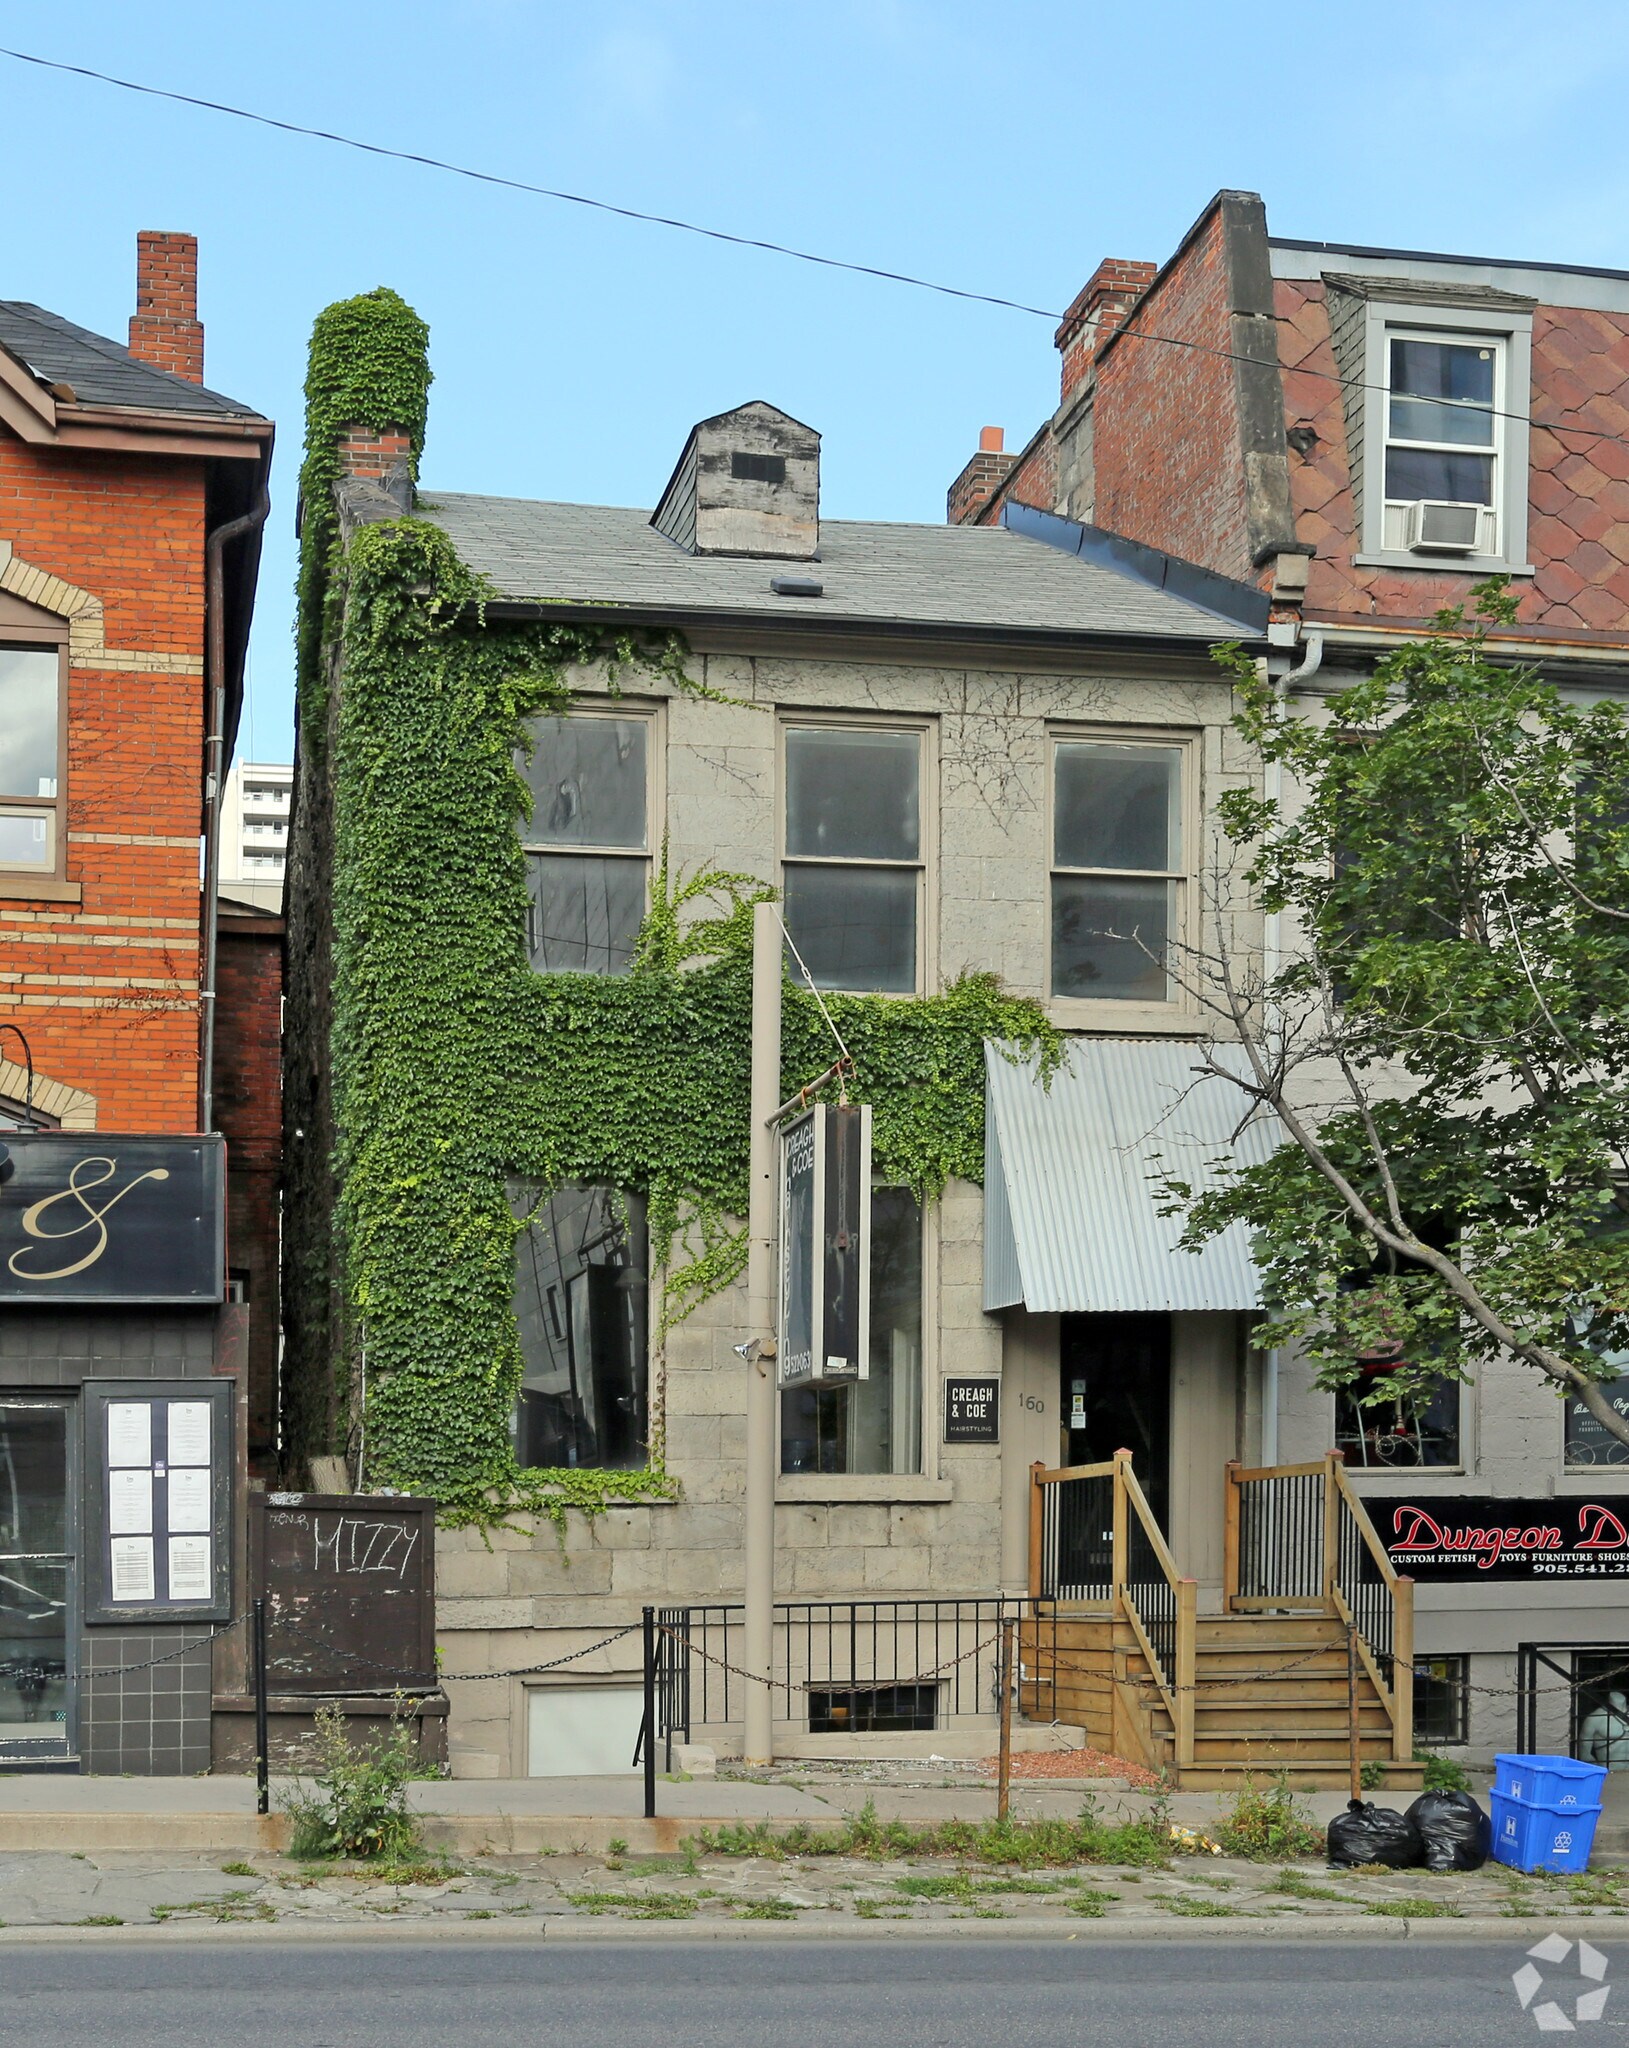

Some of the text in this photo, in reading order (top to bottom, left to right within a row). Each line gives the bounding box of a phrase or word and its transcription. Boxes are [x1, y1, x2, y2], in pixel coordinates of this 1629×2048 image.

[797, 1146, 814, 1174] COE
[952, 1387, 993, 1402] CREAGH
[1019, 1392, 1044, 1413] 160
[951, 1403, 987, 1418] & COE
[1613, 1397, 1629, 1415] Pag
[1388, 1504, 1629, 1569] Dungeon D
[1390, 1554, 1436, 1563] CUSTOM
[1437, 1553, 1477, 1563] FETISH
[1499, 1553, 1527, 1562] TOYS
[1531, 1552, 1594, 1561] FURNITURE
